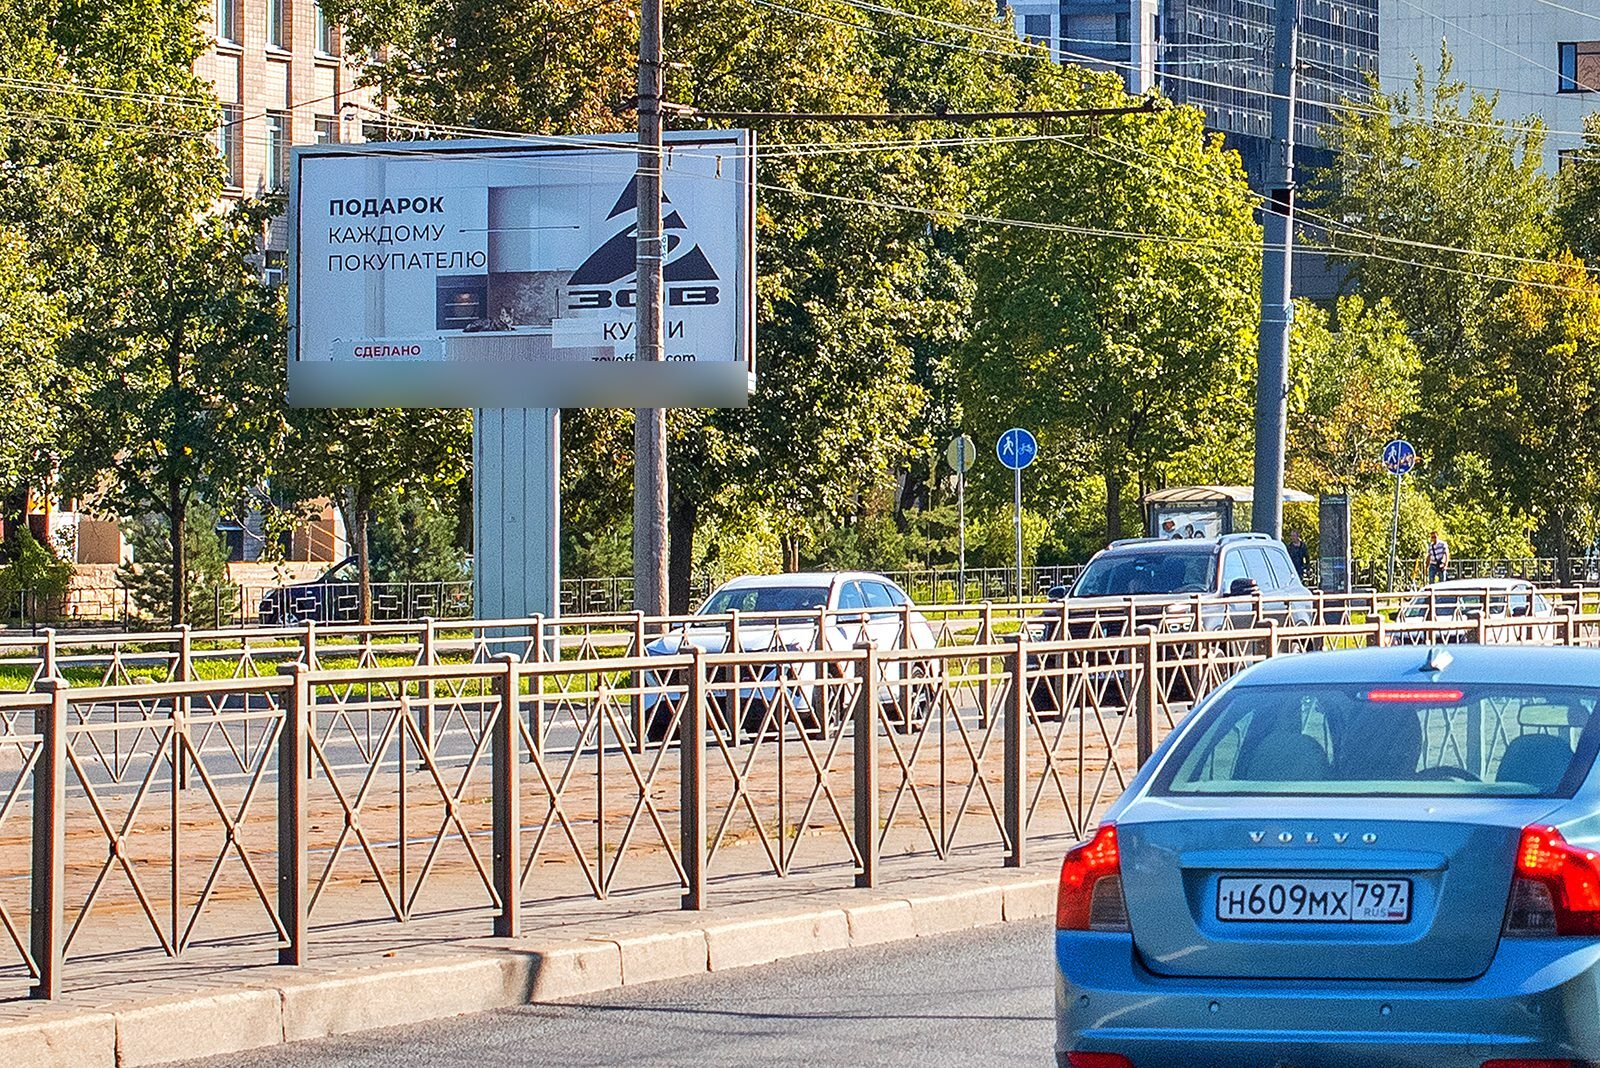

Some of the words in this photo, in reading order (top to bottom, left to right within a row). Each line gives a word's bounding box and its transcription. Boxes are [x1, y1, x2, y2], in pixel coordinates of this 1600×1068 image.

[329, 196, 444, 218] ПОДАРОК
[328, 224, 446, 246] КАЖДОМУ
[328, 250, 487, 272] ПОКУПАТЕЛЮ
[603, 320, 684, 341] КУИ
[354, 345, 421, 359] СДЕЛАНО
[1249, 831, 1378, 844] VOLVO
[1363, 907, 1386, 918] RUS
